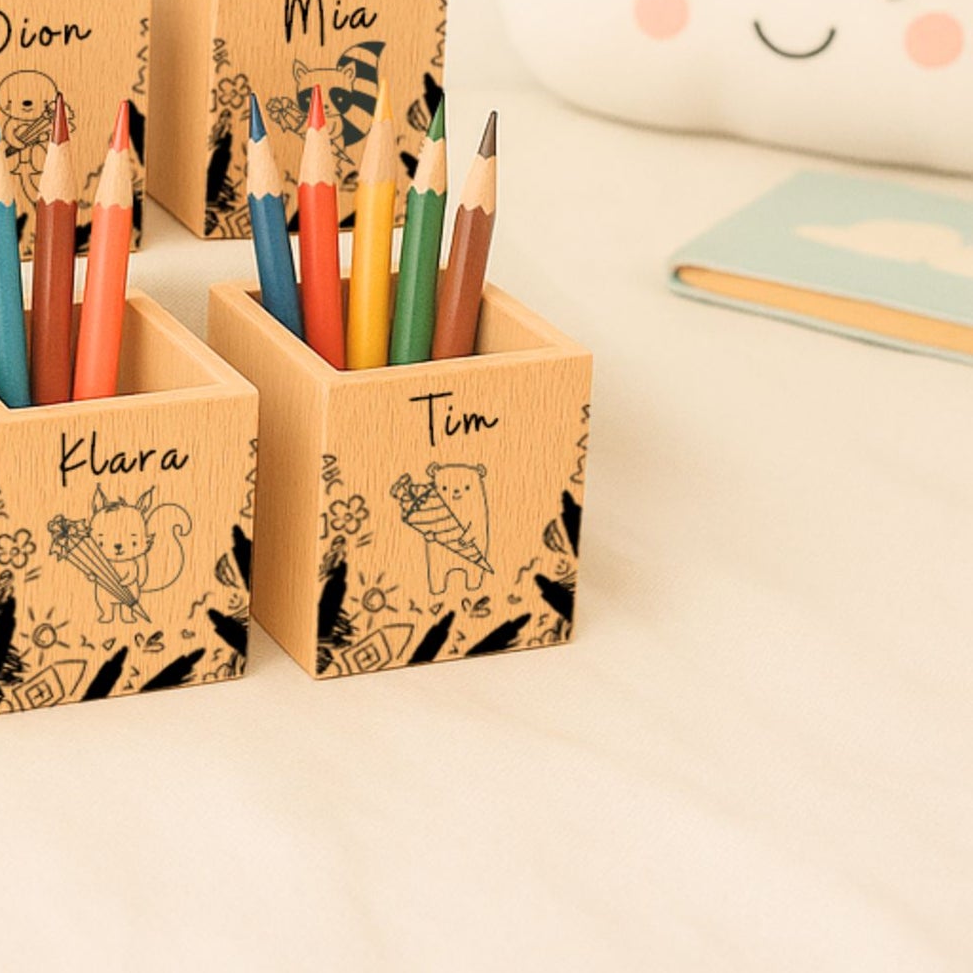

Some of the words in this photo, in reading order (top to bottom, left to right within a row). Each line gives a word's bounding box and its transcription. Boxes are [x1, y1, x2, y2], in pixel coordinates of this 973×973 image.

[212, 37, 231, 74] ABC
[409, 391, 499, 448] Tim
[58, 430, 189, 487] Klara
[321, 453, 345, 495] ABC
